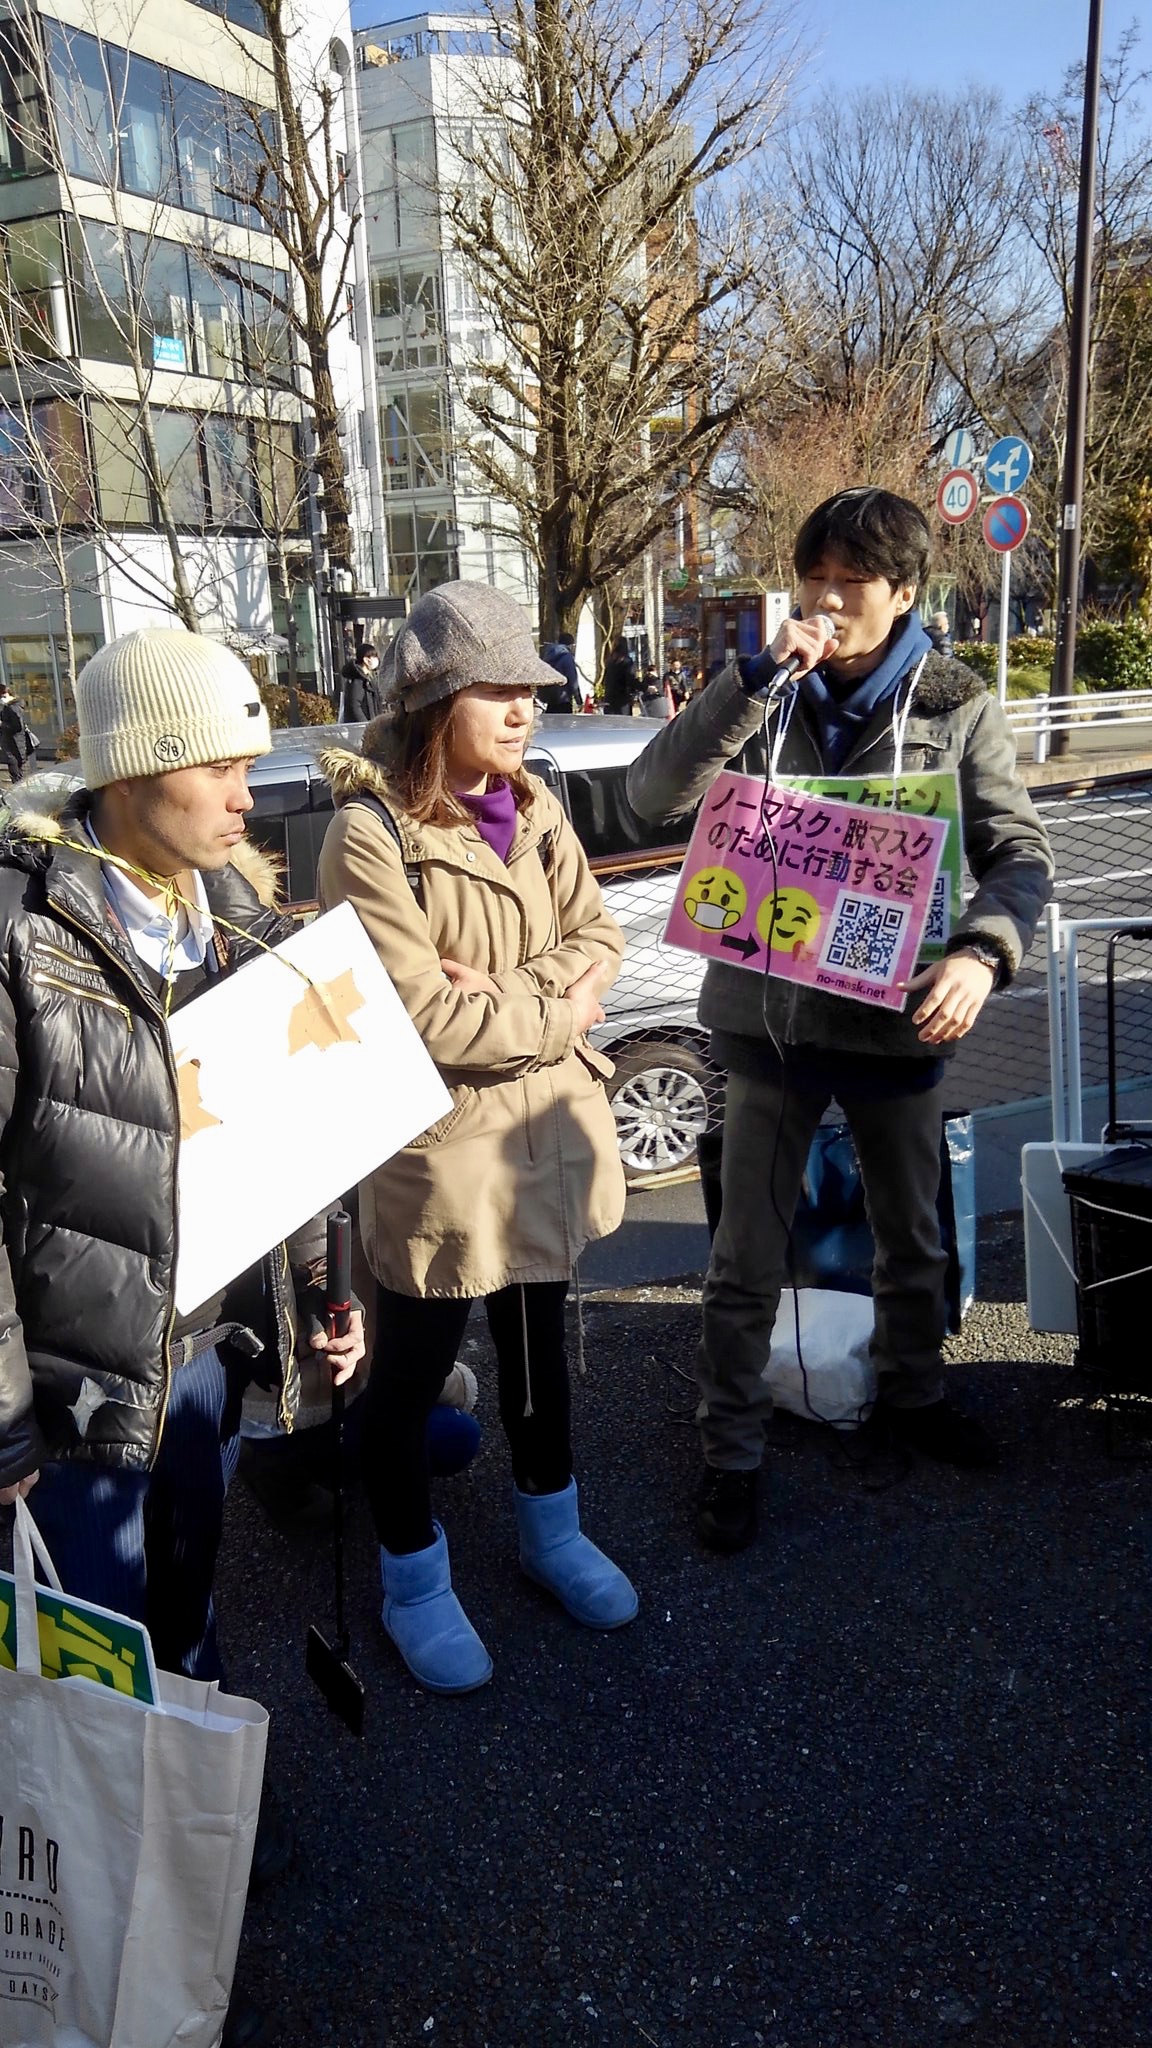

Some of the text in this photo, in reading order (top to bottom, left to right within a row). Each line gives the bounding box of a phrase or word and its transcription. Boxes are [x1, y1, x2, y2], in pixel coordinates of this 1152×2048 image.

[946, 484, 968, 508] 40
[708, 821, 919, 898] のために行動する会
[711, 788, 934, 861] ノーマスク・脱マスク
[816, 973, 886, 999] no-mask.net
[0, 1815, 59, 1894] RD
